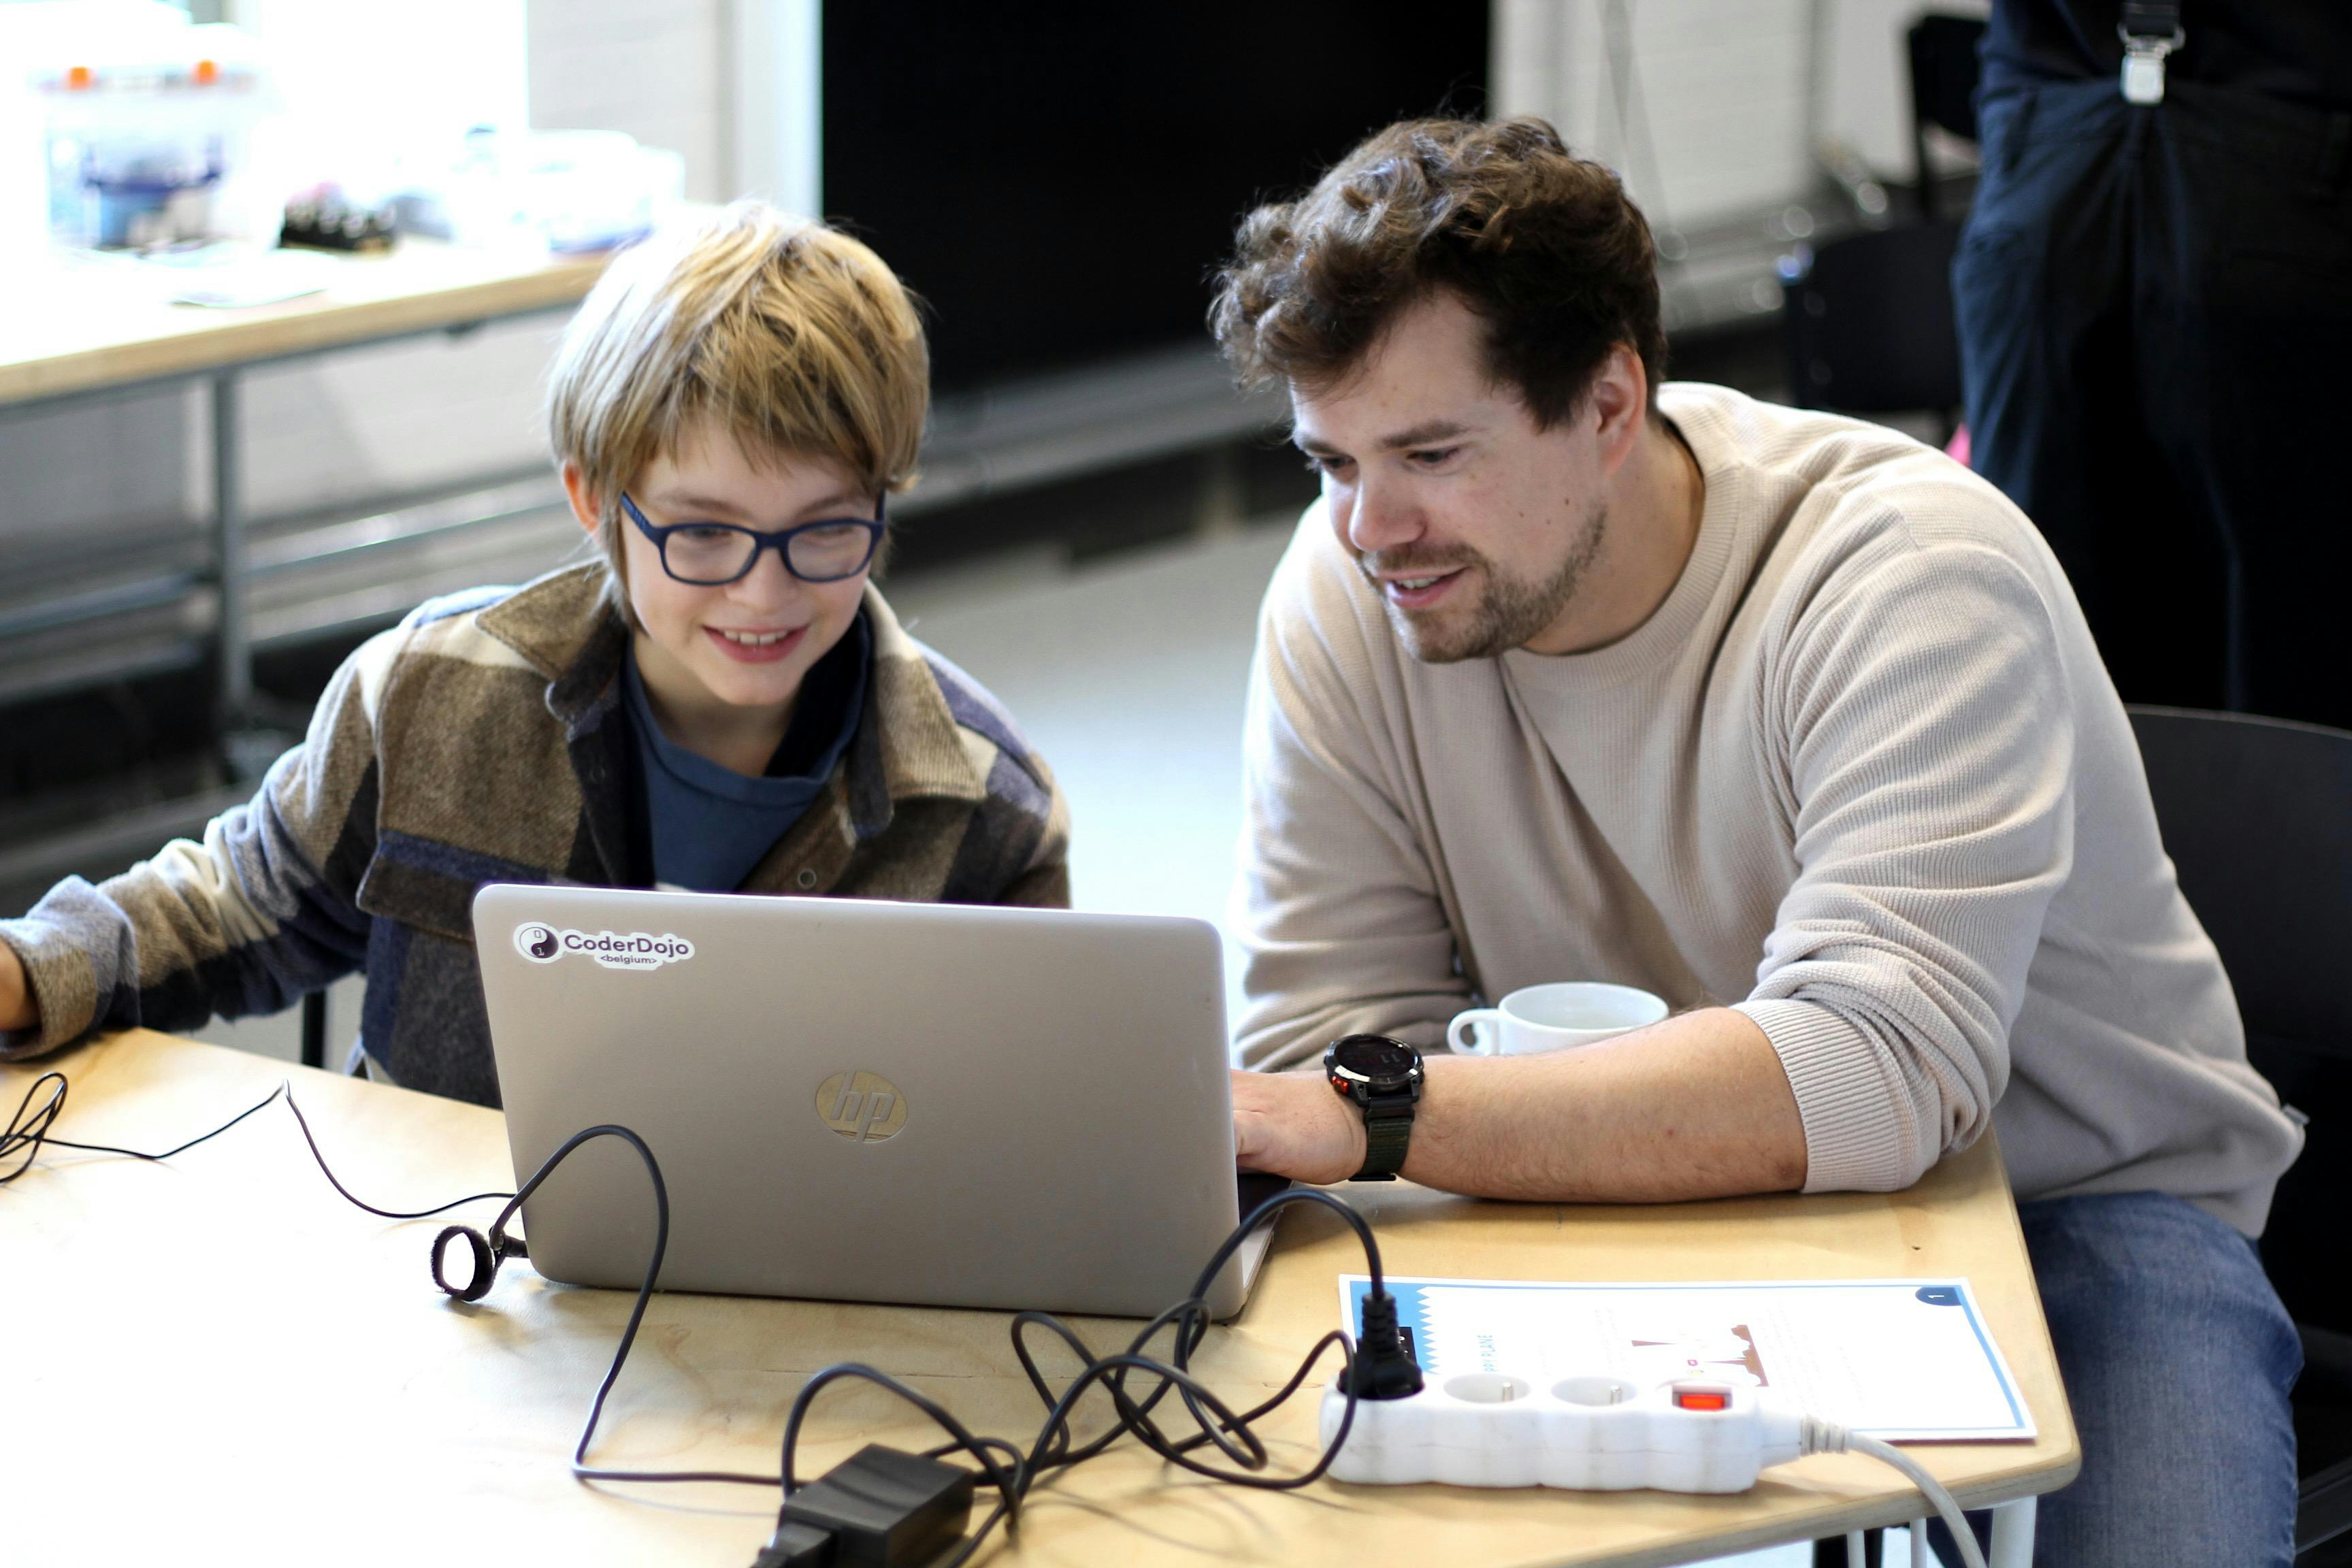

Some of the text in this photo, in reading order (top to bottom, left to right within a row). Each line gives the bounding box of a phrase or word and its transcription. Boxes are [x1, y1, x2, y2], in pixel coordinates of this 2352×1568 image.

[564, 934, 689, 958] CoderDojo
[830, 1072, 896, 1142] hp
[1477, 1334, 1497, 1357] PLANE
